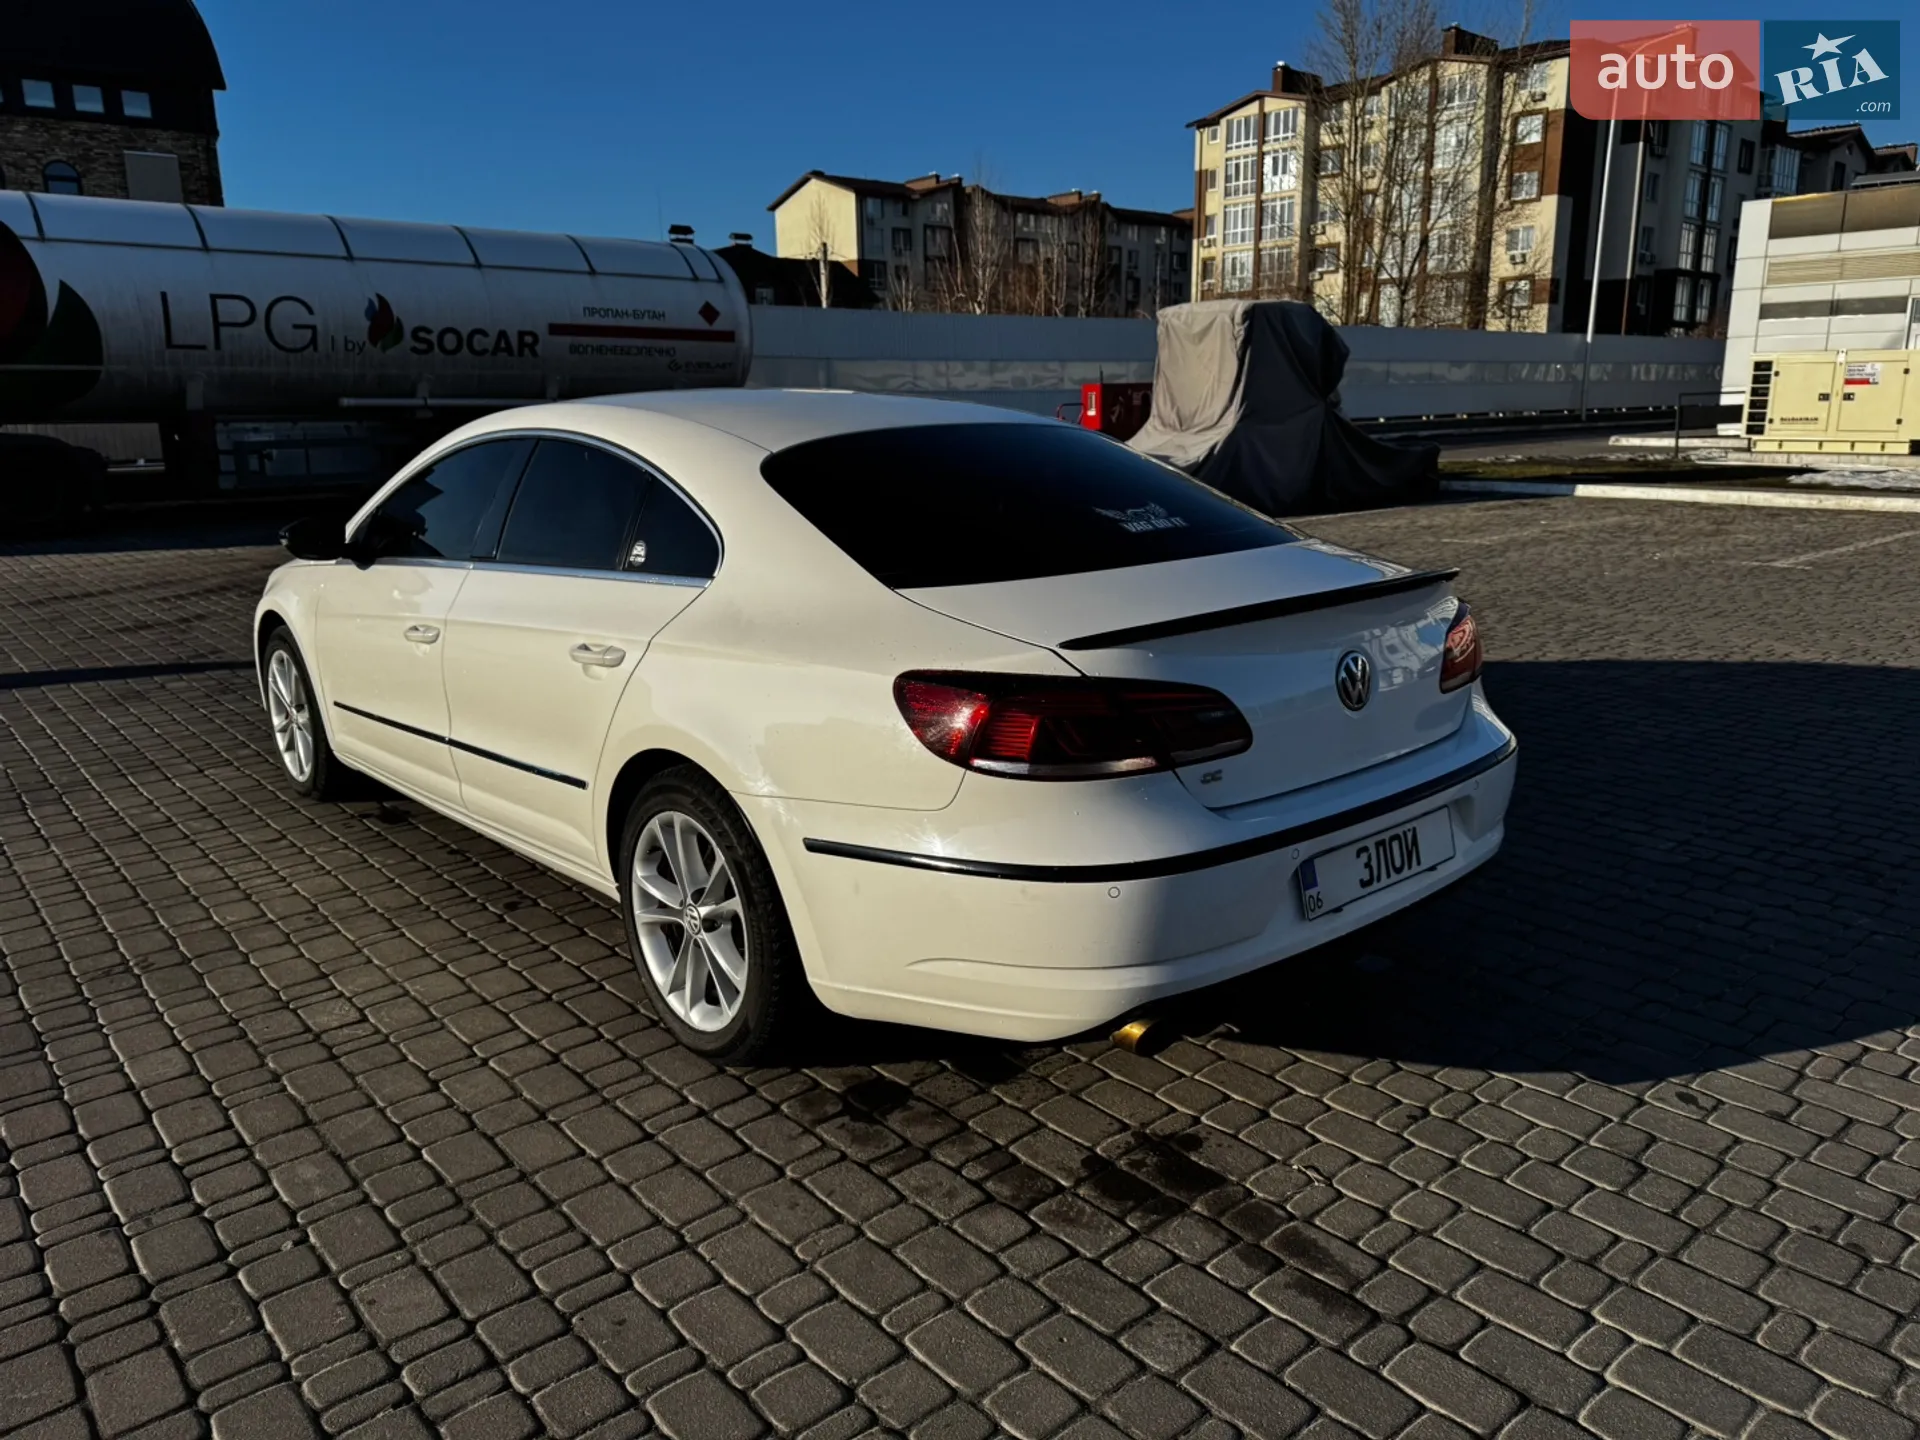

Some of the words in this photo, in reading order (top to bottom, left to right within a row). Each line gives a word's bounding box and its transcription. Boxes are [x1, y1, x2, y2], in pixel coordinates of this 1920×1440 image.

[160, 290, 319, 354] LPG
[343, 335, 367, 355] by
[409, 325, 540, 358] SOCAR
[582, 306, 666, 321] ПРОПАН-БУТАН
[1355, 826, 1421, 889] ЗЛОЙ
[1307, 891, 1324, 913] 06
